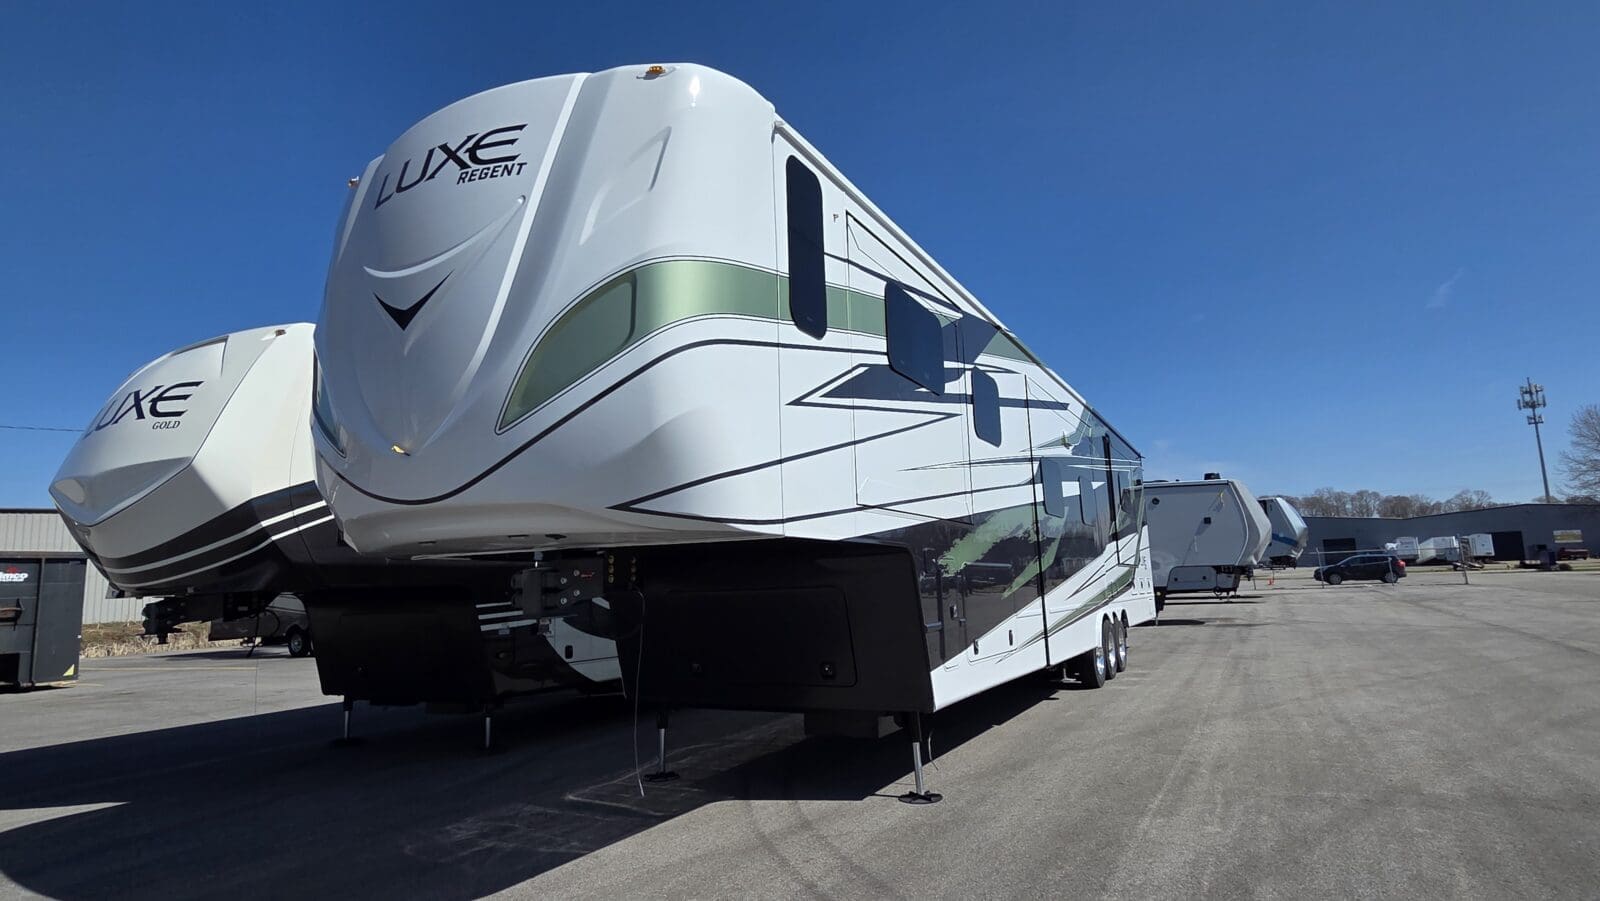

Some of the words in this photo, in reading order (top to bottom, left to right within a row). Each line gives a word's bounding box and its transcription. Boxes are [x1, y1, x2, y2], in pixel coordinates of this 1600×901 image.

[374, 123, 529, 210] LUXE
[456, 162, 528, 185] REGENT
[151, 420, 181, 430] GOLD
